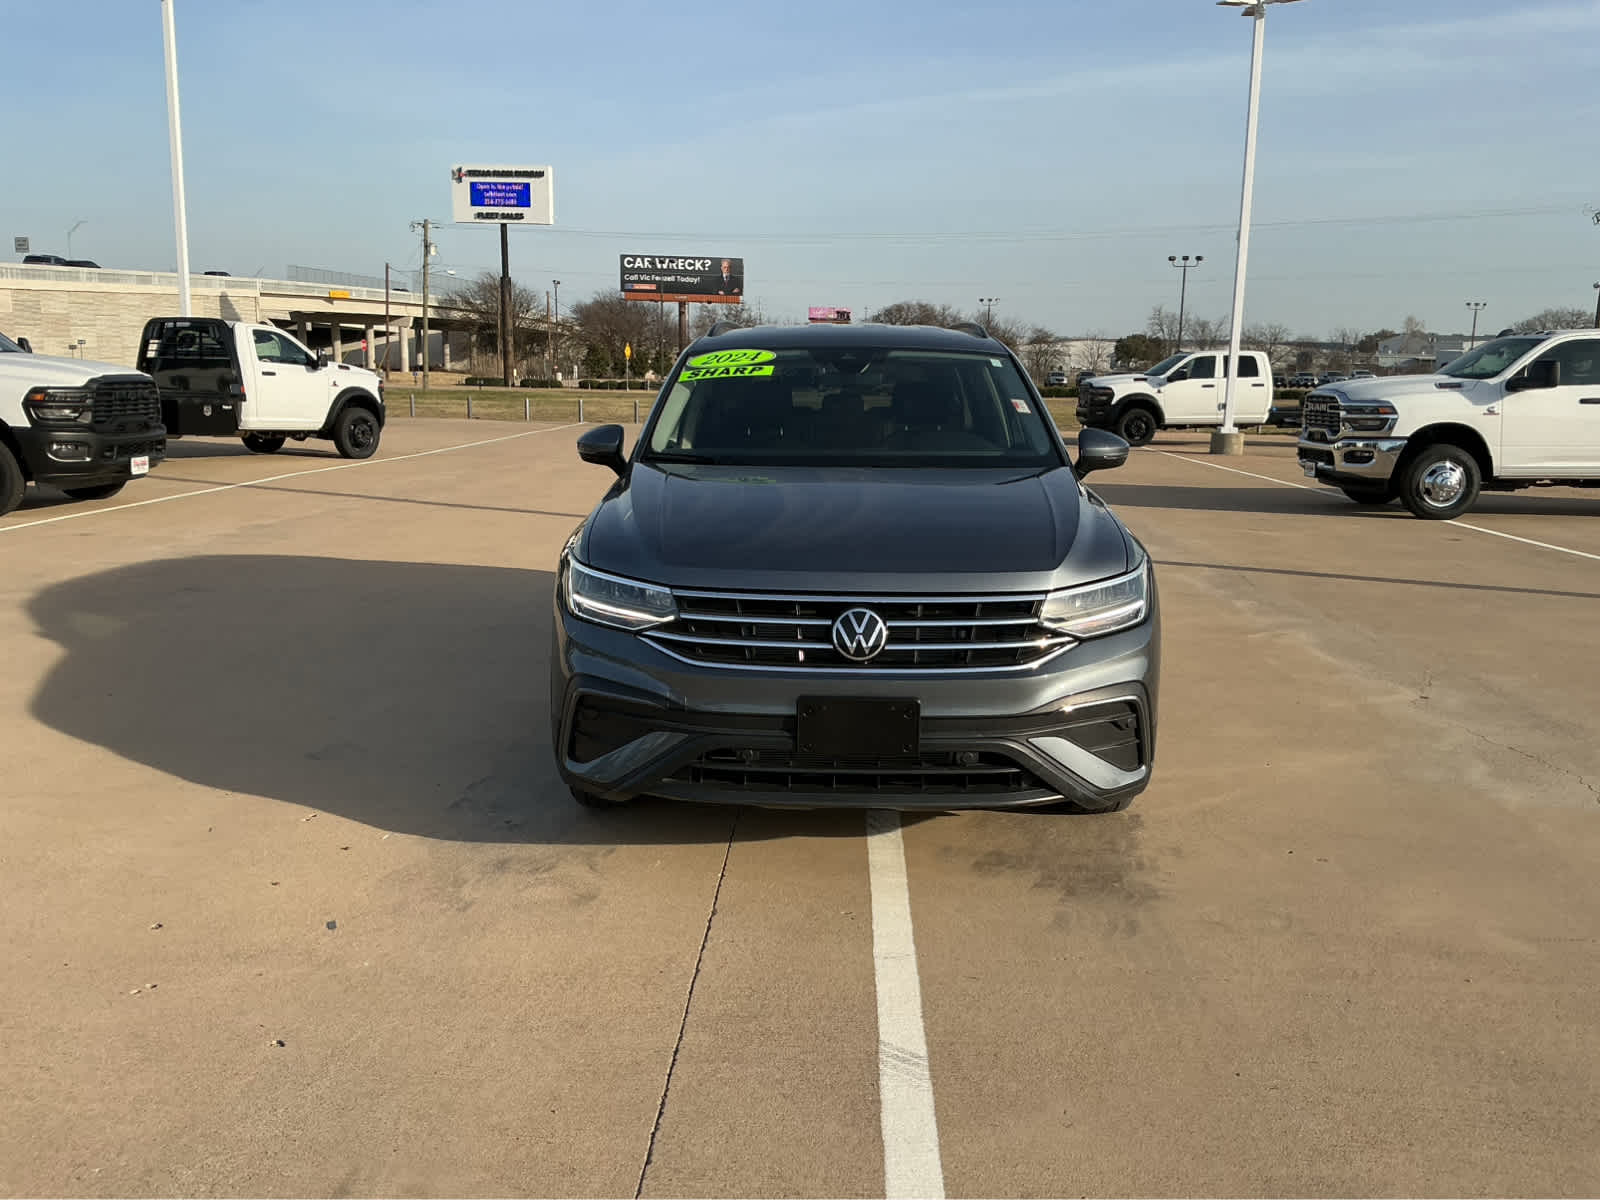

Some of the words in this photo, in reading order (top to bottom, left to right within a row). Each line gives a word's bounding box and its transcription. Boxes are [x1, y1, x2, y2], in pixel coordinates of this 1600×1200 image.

[624, 257, 652, 268] CAR
[656, 258, 711, 270] WRECK?
[677, 276, 700, 284] Today!
[687, 367, 763, 379] SHARP
